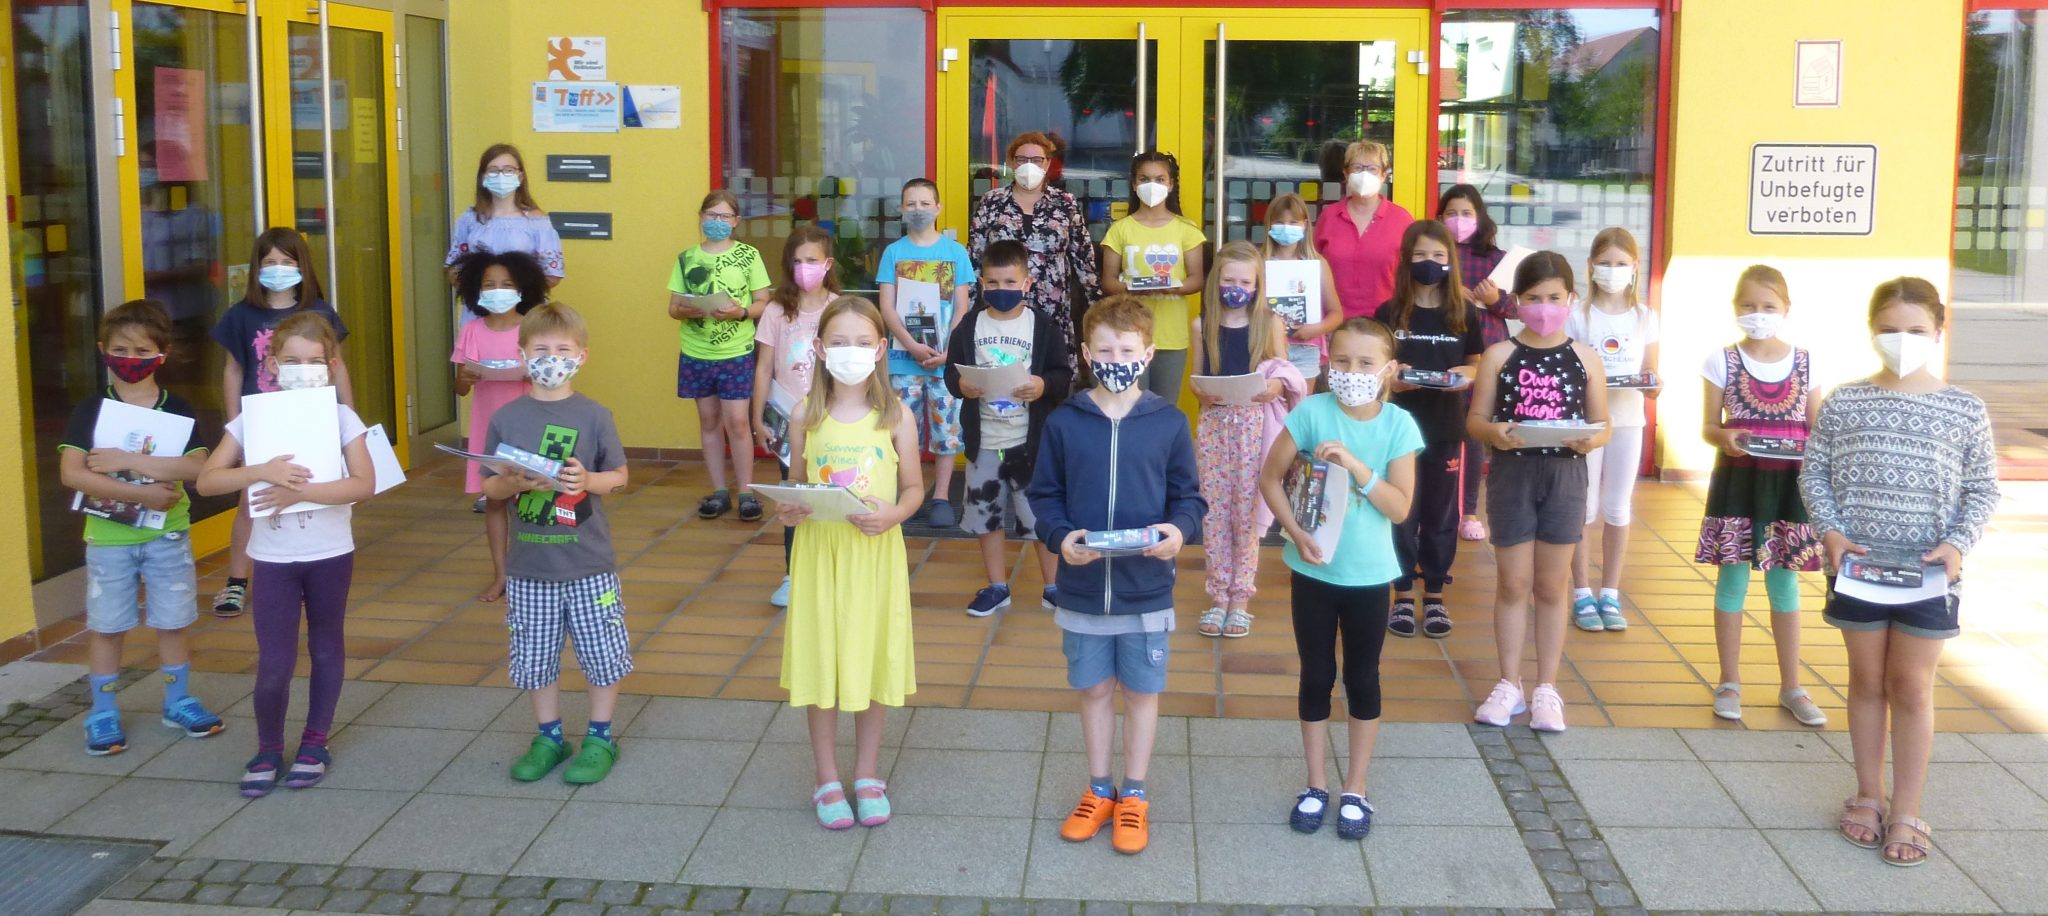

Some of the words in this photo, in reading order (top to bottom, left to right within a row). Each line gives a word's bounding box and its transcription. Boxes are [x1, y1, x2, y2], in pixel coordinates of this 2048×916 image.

[1761, 155, 1825, 172] Zutritt
[1836, 155, 1866, 173] für
[1760, 180, 1865, 203] Unbefugte
[1766, 205, 1857, 224] verboten
[1000, 335, 1032, 351] FRIENDS
[824, 442, 865, 453] Summer
[558, 508, 574, 518] TNT
